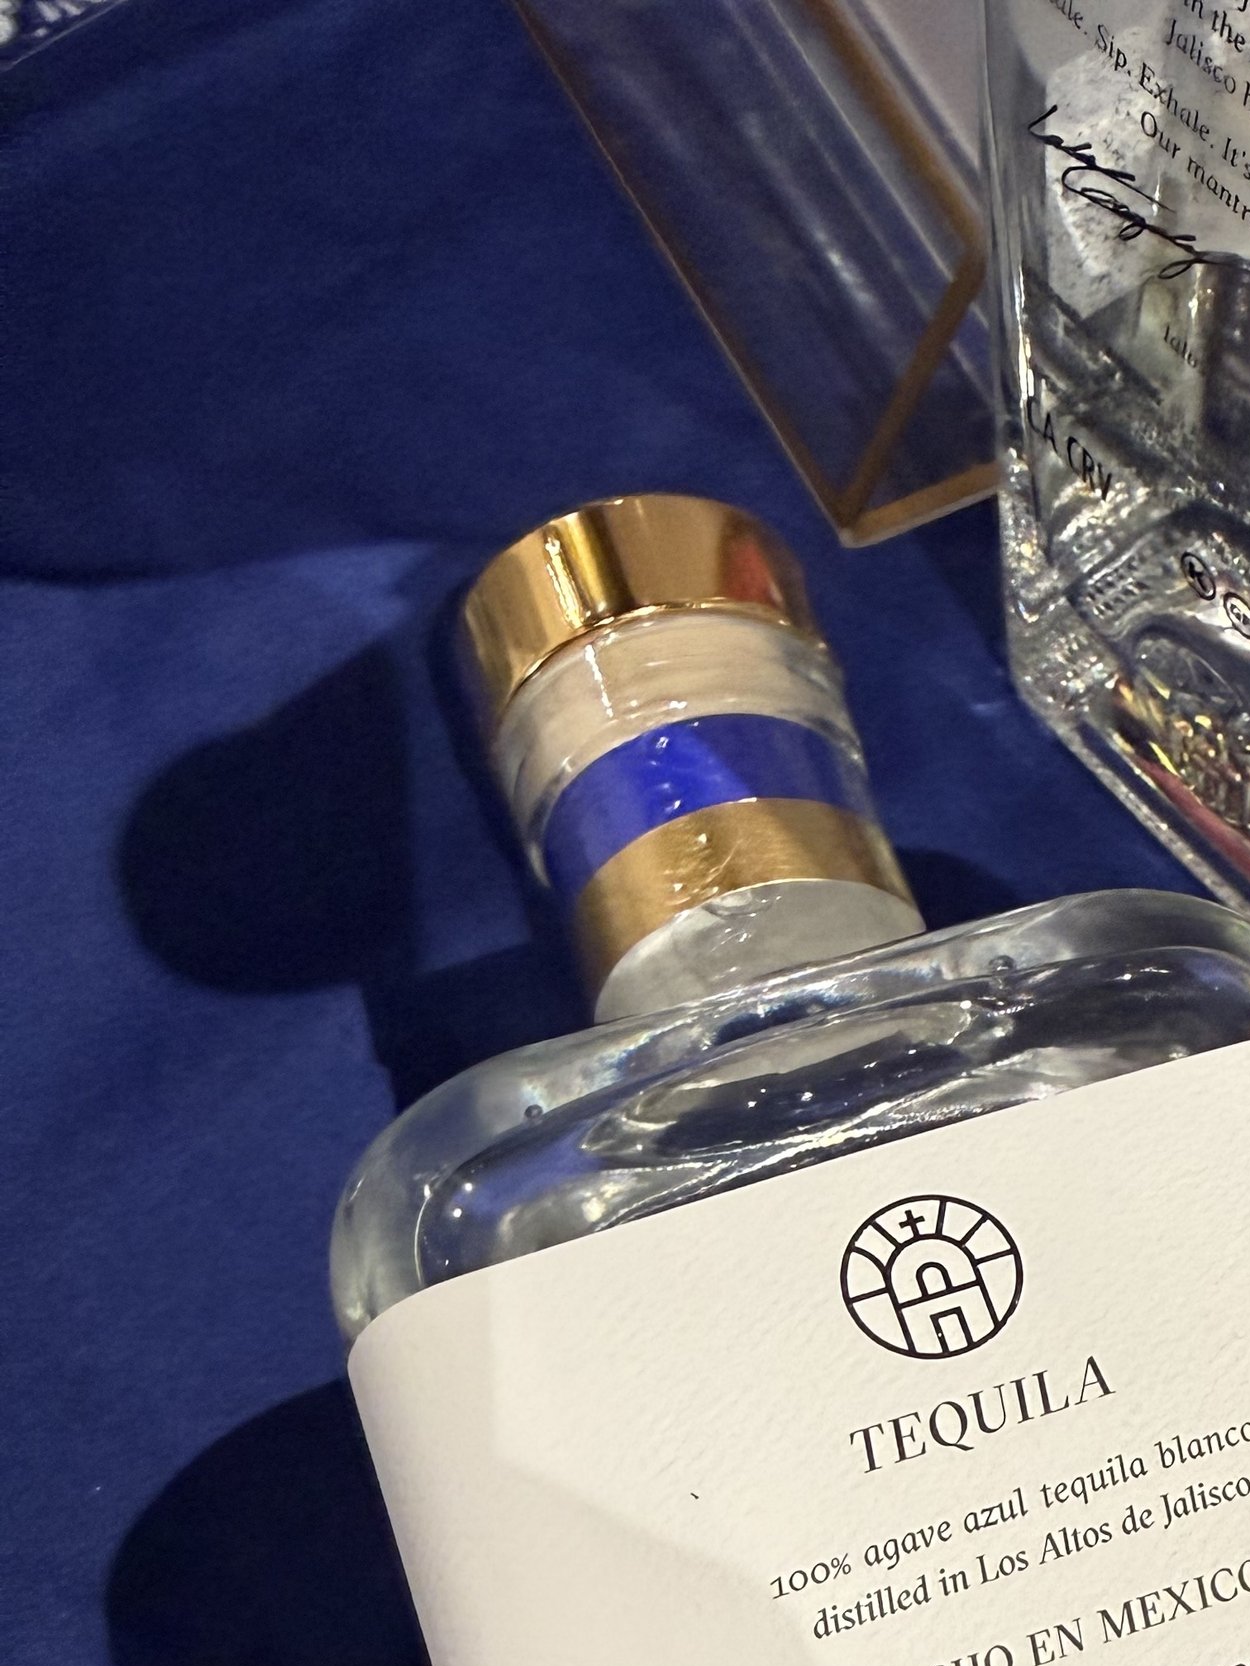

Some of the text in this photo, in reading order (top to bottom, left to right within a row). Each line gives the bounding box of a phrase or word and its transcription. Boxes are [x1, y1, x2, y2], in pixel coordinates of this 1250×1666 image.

[1094, 24, 1132, 76] Sip.
[1138, 62, 1215, 149] Exhale.
[1164, 19, 1237, 94] Jalisco
[1211, 10, 1246, 53] the
[1140, 111, 1181, 160] Our
[849, 1354, 1117, 1475] TEQUILA
[770, 1552, 852, 1600] 100%
[863, 1518, 954, 1571] agave
[963, 1488, 1029, 1533] azul
[1039, 1453, 1149, 1514] tequila
[812, 1575, 932, 1640] distilled
[939, 1565, 972, 1597] in
[976, 1545, 1030, 1588] Los
[1038, 1523, 1113, 1566] Altos
[1120, 1499, 1155, 1535] de
